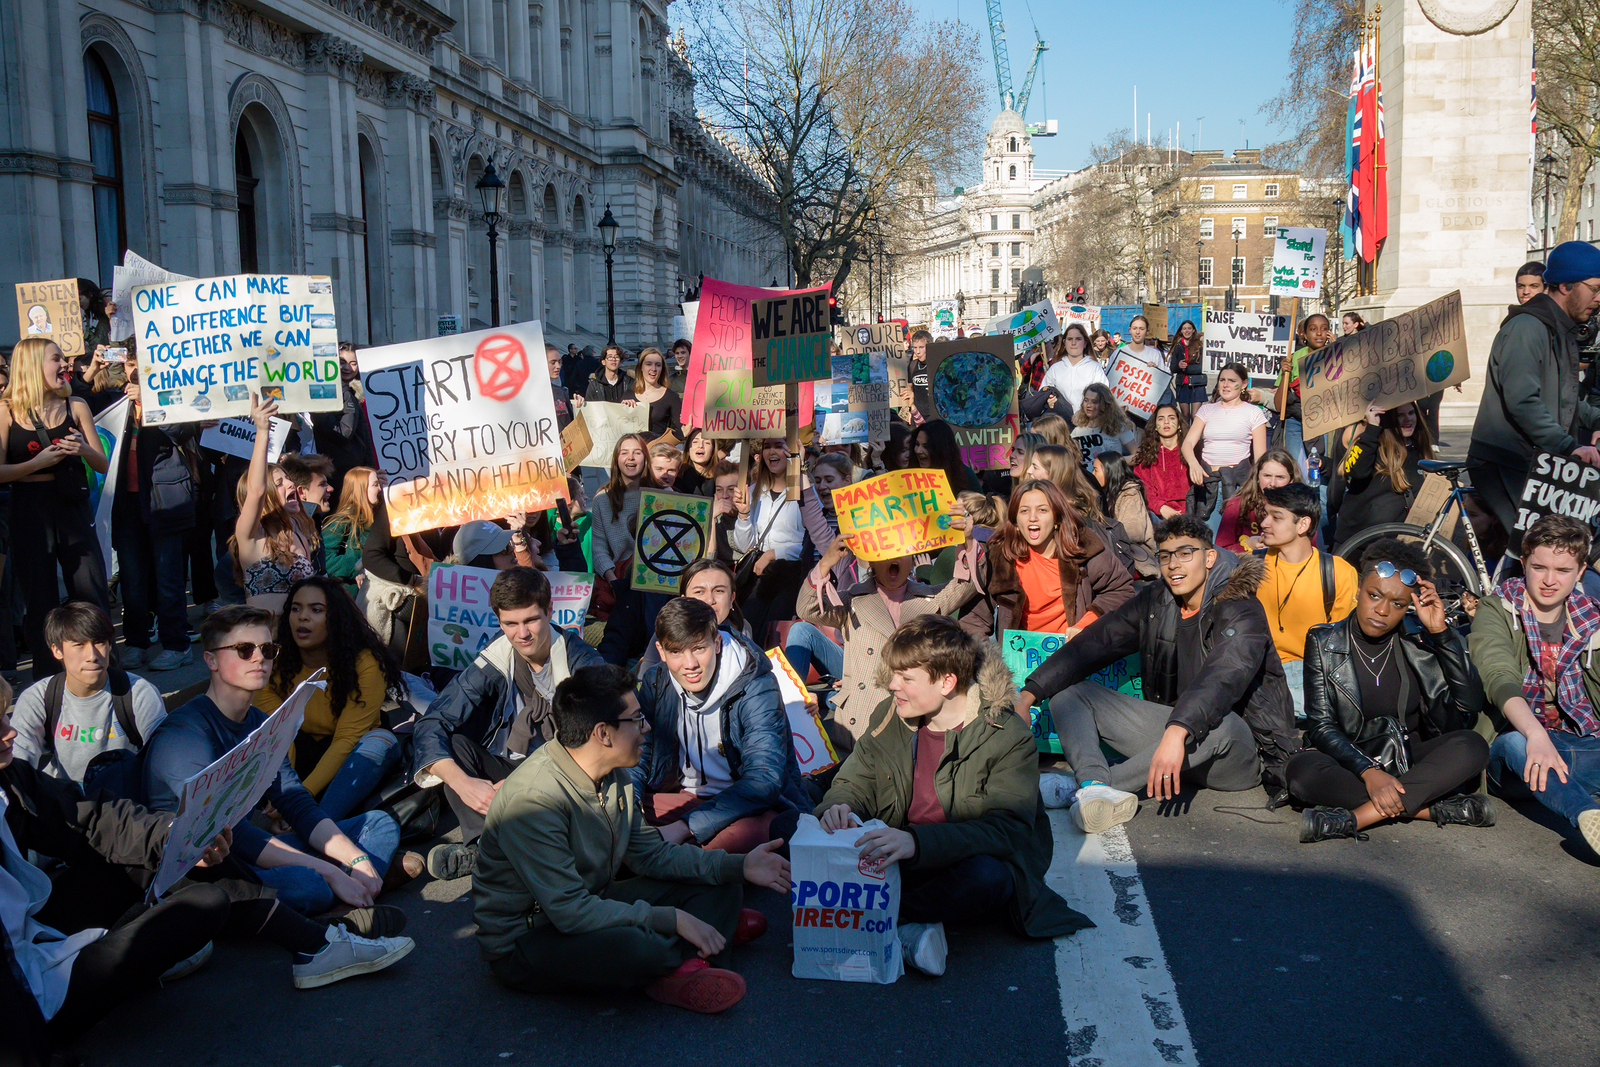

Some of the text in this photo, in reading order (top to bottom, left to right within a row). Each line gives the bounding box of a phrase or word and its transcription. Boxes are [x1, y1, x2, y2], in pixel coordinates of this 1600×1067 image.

[1451, 178, 1478, 188] THE
[1426, 197, 1503, 208] GLORIOUS
[1442, 215, 1485, 227] DEAD
[1277, 229, 1289, 239] I
[1301, 268, 1310, 276] I
[20, 283, 76, 304] LISTEN
[136, 276, 290, 313] ONE CAN MAKE
[59, 300, 79, 317] TO
[710, 293, 751, 324] PEOPL
[752, 294, 827, 340] WE ARE
[1038, 308, 1048, 320] NO
[1206, 311, 1286, 328] RAISE YOUR
[59, 316, 81, 332] HIM
[145, 304, 314, 339] A DIFFERENCE BUT
[1228, 325, 1268, 342] VOICE
[708, 322, 744, 352] STOP
[846, 325, 903, 345] YOU'RE
[1016, 325, 1055, 350] LANET B
[1206, 339, 1287, 354] NOT THE
[1305, 293, 1461, 389] FUCK BREXIT
[147, 328, 311, 369] TOGETHER WE CAN
[752, 333, 832, 383] THE CHANGE
[1115, 359, 1153, 385] FOSSIL
[1206, 350, 1287, 375] TEMPERATUR
[147, 357, 338, 395] CHANGE THE WORLD
[365, 354, 474, 420] START
[1118, 376, 1150, 397] FUELS
[715, 377, 754, 407] 200
[1123, 393, 1157, 414] ANGER
[1304, 358, 1417, 429] SAVE OUR
[379, 412, 445, 441] SAYING
[704, 408, 786, 432] WHO'S NEXT
[867, 408, 887, 420] WHAT
[868, 421, 887, 431] NEXT
[219, 422, 257, 443] CHANG
[966, 427, 1012, 446] WITH
[381, 417, 554, 475] SORRY TO YOUR
[1536, 453, 1600, 489] STOP
[386, 456, 566, 512] GRANDCHILDREN
[835, 472, 941, 509] MAKE THE
[850, 489, 939, 529] EARTH
[1522, 478, 1600, 527] FUCKING
[847, 515, 931, 553] PRETTY
[906, 534, 947, 554] AGAIN
[1465, 523, 1486, 574] COUGAR
[434, 604, 500, 628] LEAVE
[432, 642, 480, 668] SAV
[791, 880, 890, 910] SPORTS
[801, 945, 878, 957] www.sportsdirect.com
